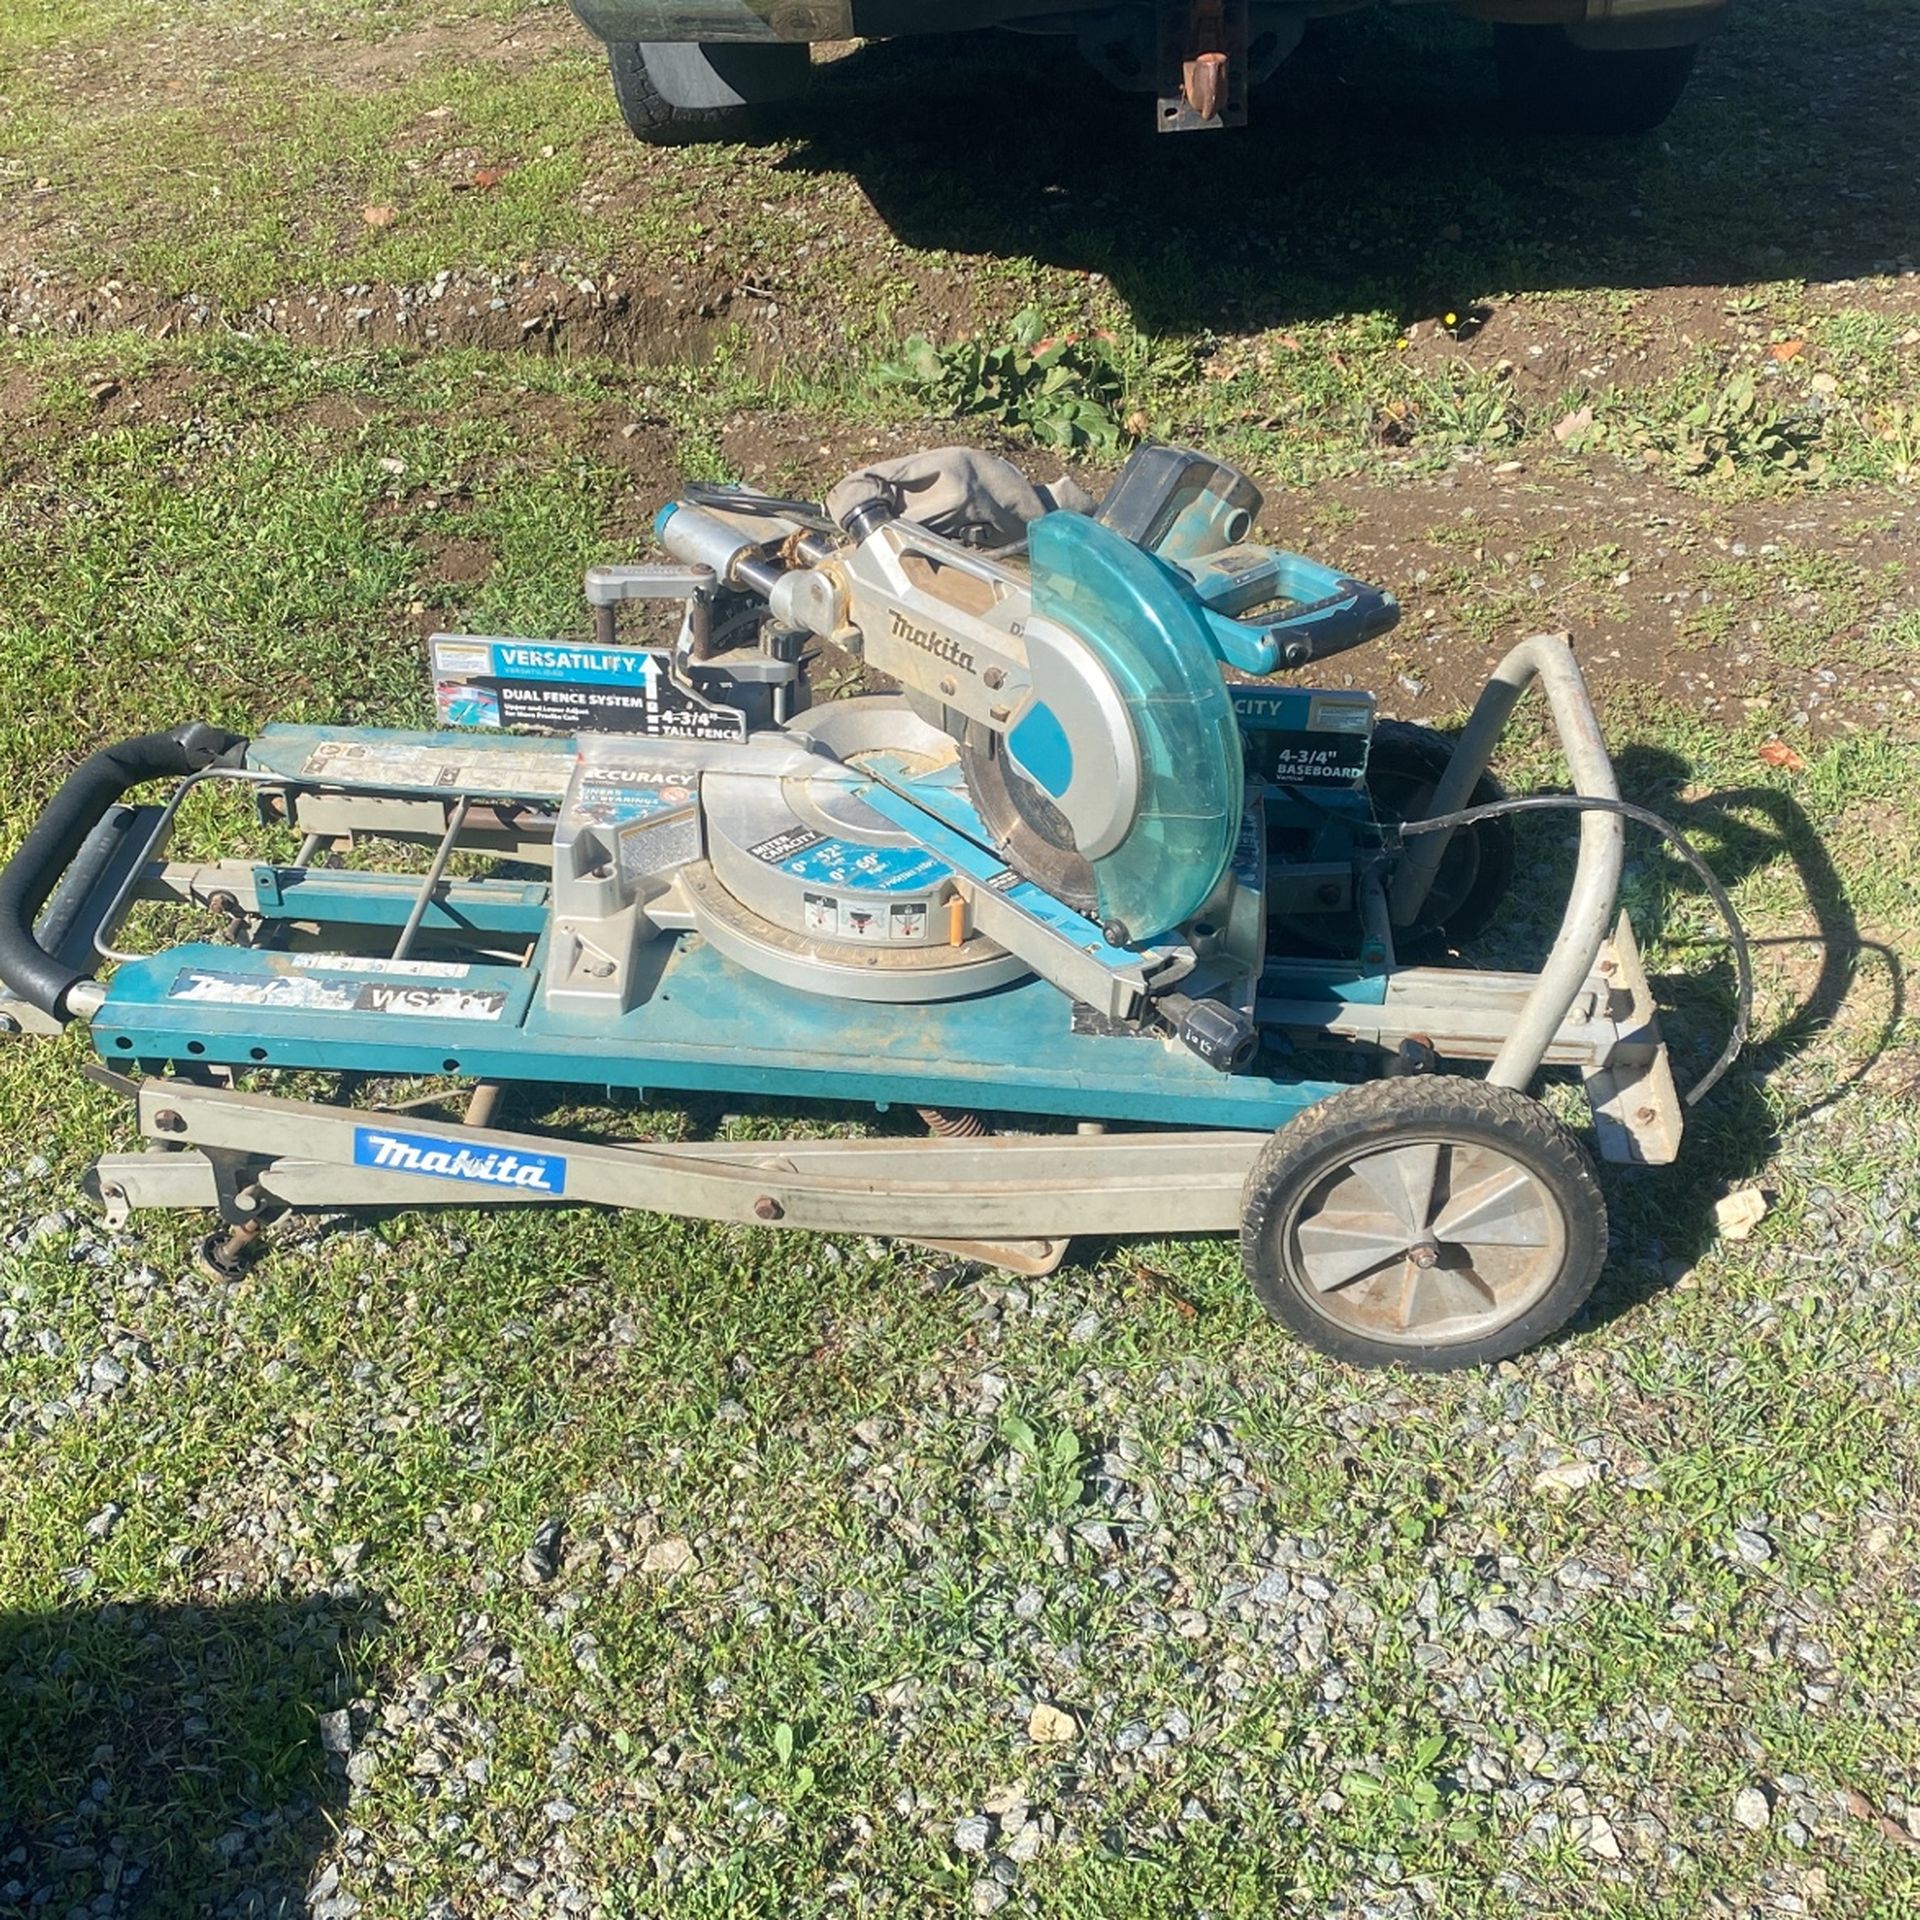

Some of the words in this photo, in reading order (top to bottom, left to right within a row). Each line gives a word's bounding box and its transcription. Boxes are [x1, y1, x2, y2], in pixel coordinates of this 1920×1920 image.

[501, 649, 636, 672] VERSATILITY
[502, 688, 541, 701] DUAL
[543, 691, 587, 705] FENCE
[589, 694, 644, 708] SYSTEM
[662, 726, 695, 737] TALL
[697, 728, 739, 739] FENCE
[1279, 749, 1337, 765] 4-3/4"
[1277, 764, 1362, 778] BASEBOARD
[760, 831, 816, 860] CAPACITY
